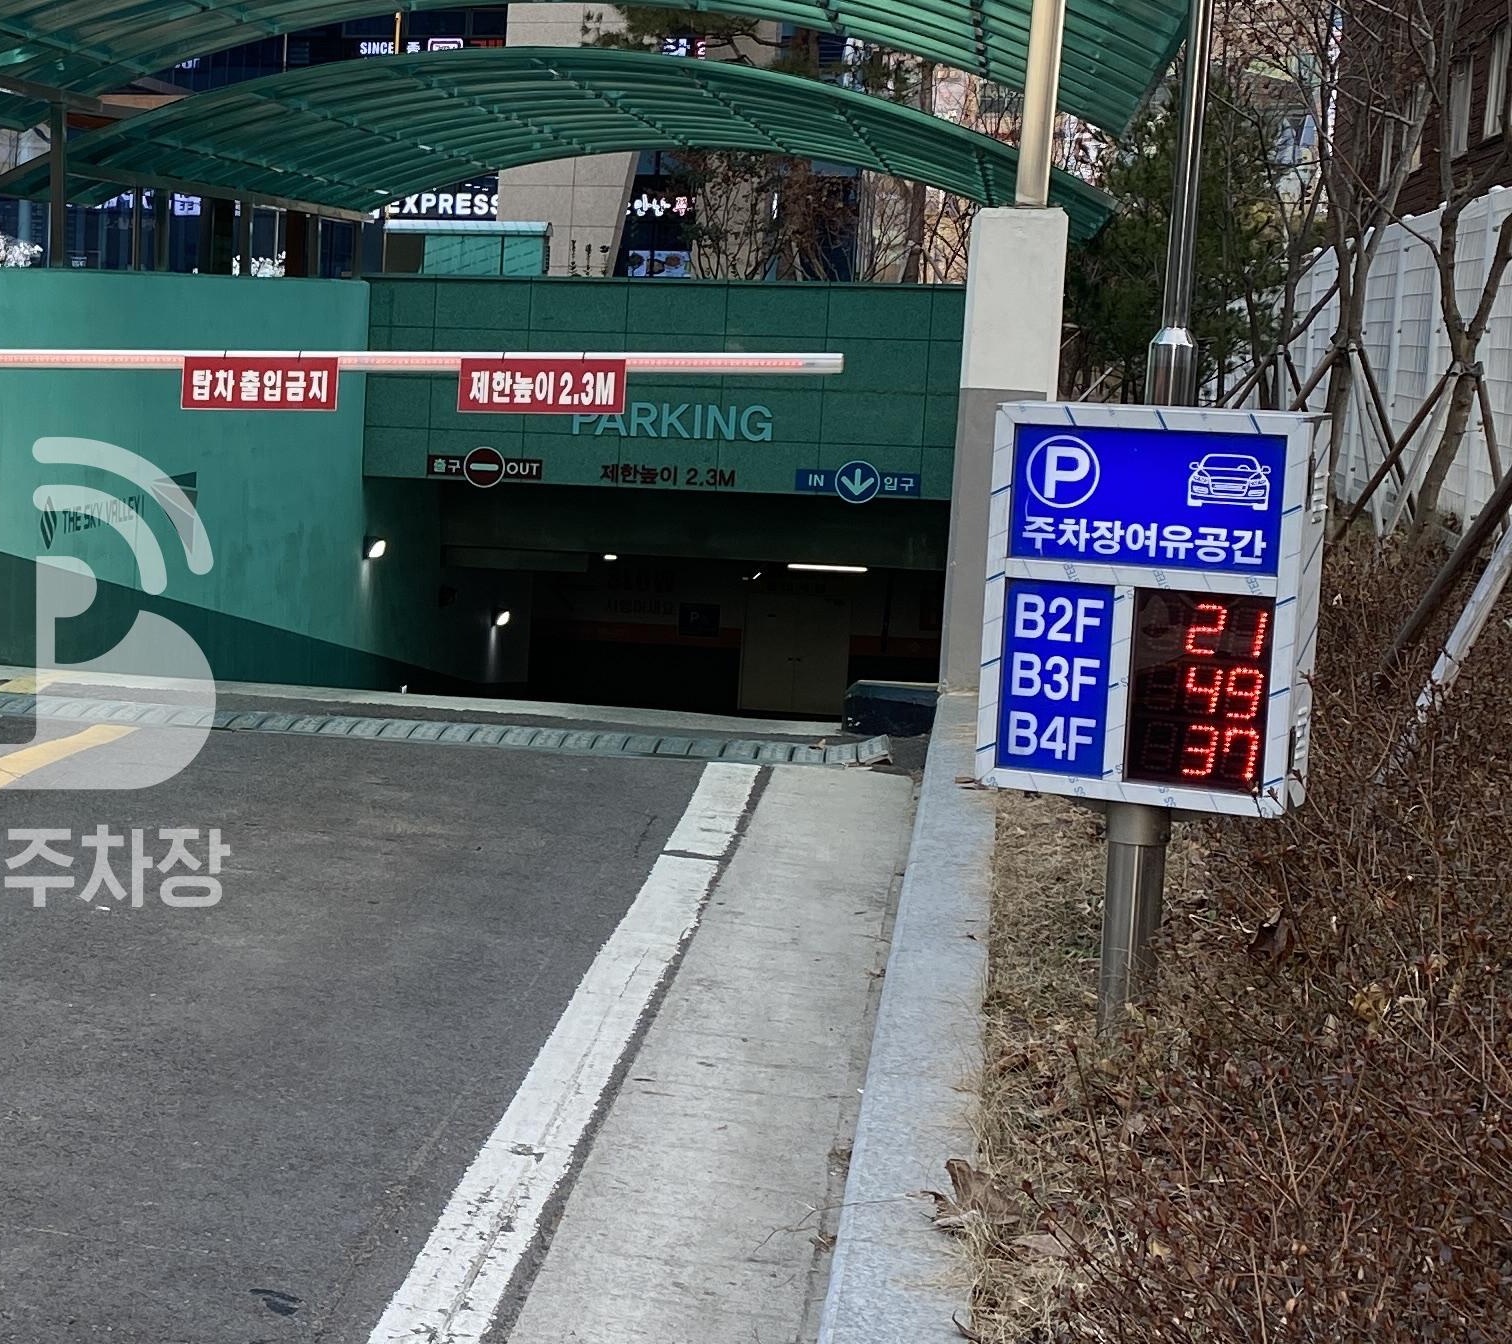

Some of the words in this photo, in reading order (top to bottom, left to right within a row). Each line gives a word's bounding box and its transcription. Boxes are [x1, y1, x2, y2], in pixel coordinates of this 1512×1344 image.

[469, 370, 554, 406] 제한높이
[559, 370, 616, 407] 2.3M
[571, 401, 775, 442] PARKING
[433, 458, 461, 474] 출구
[506, 462, 539, 477] OUT
[600, 462, 677, 487] 제한높이
[685, 467, 736, 488] 2.3M
[808, 473, 824, 488] IN
[883, 476, 915, 492] 입구
[63, 506, 82, 534] THE
[83, 501, 104, 530] SKY
[1022, 515, 1267, 565] 주차장여유공간
[1014, 593, 1105, 643] B2F
[1185, 603, 1268, 658] 21
[1011, 651, 1101, 702] B3F
[1186, 666, 1265, 720] 49
[1007, 710, 1097, 761] B4F
[1182, 724, 1260, 780] 37
